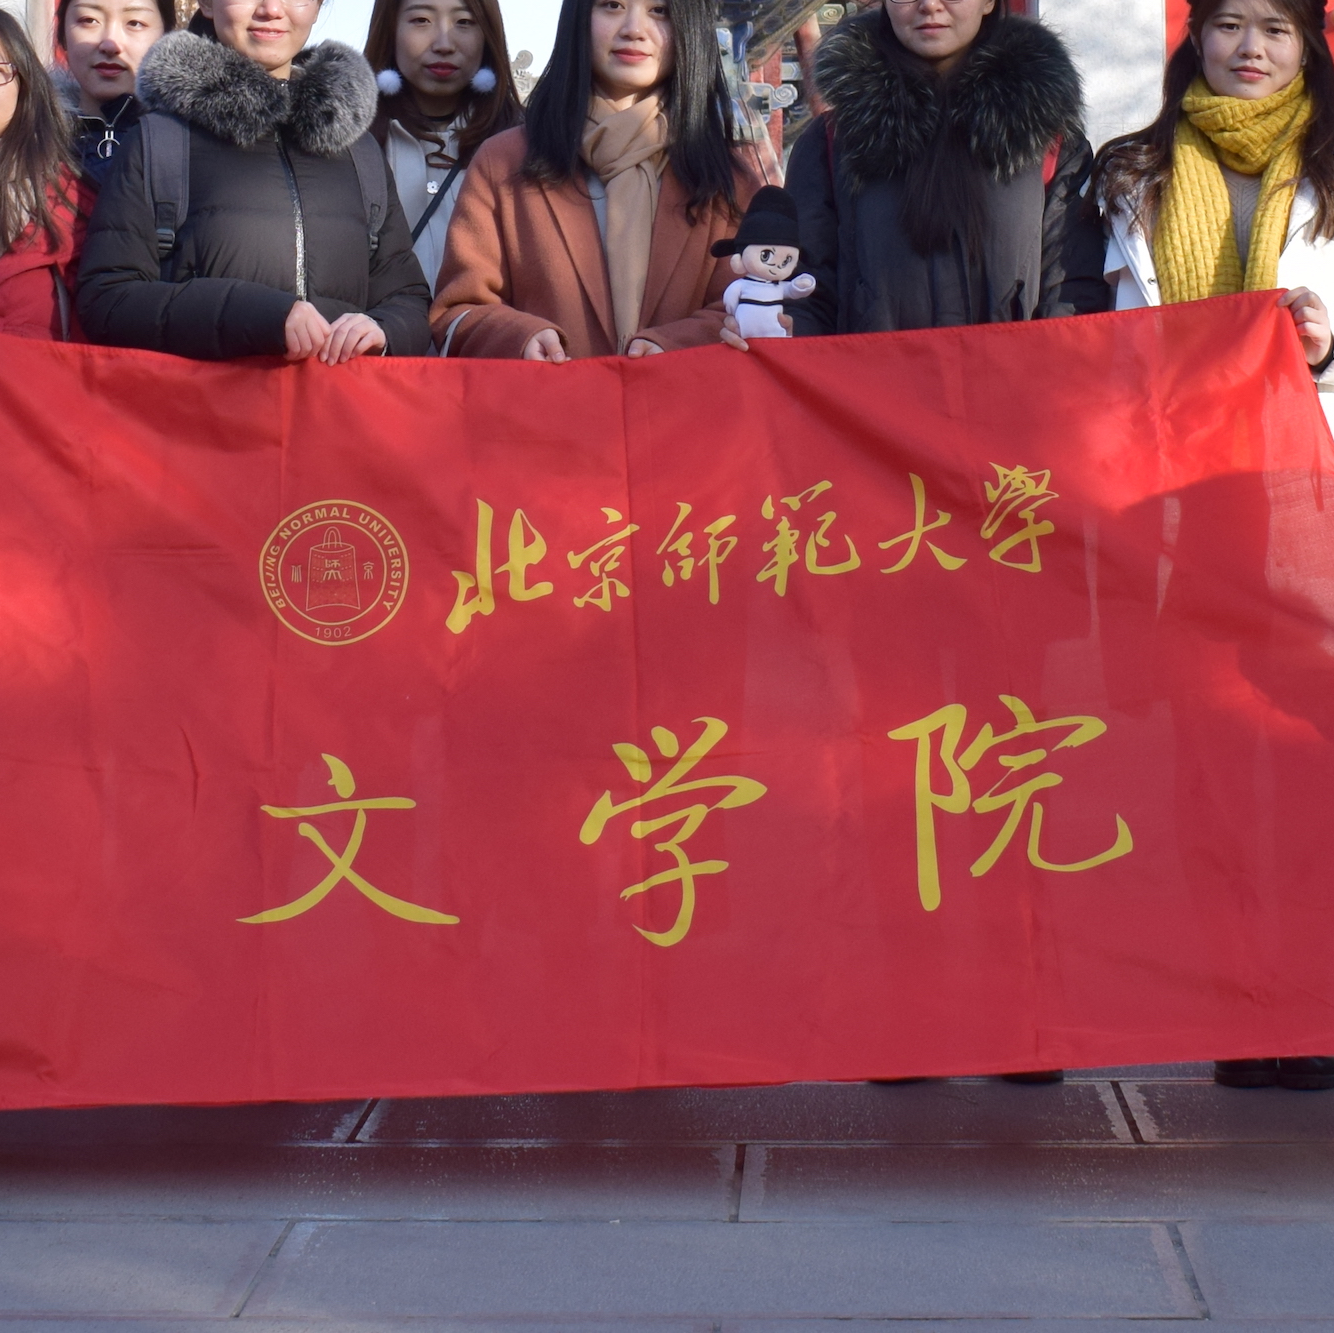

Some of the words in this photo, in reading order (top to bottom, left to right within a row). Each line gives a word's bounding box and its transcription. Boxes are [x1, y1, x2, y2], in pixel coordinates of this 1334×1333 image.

[266, 545, 286, 609] BEIJING
[279, 507, 350, 540] NORMAL
[358, 513, 402, 611] UNIVERSITY
[315, 626, 352, 639] 1902
[235, 694, 1133, 948] 文学院
